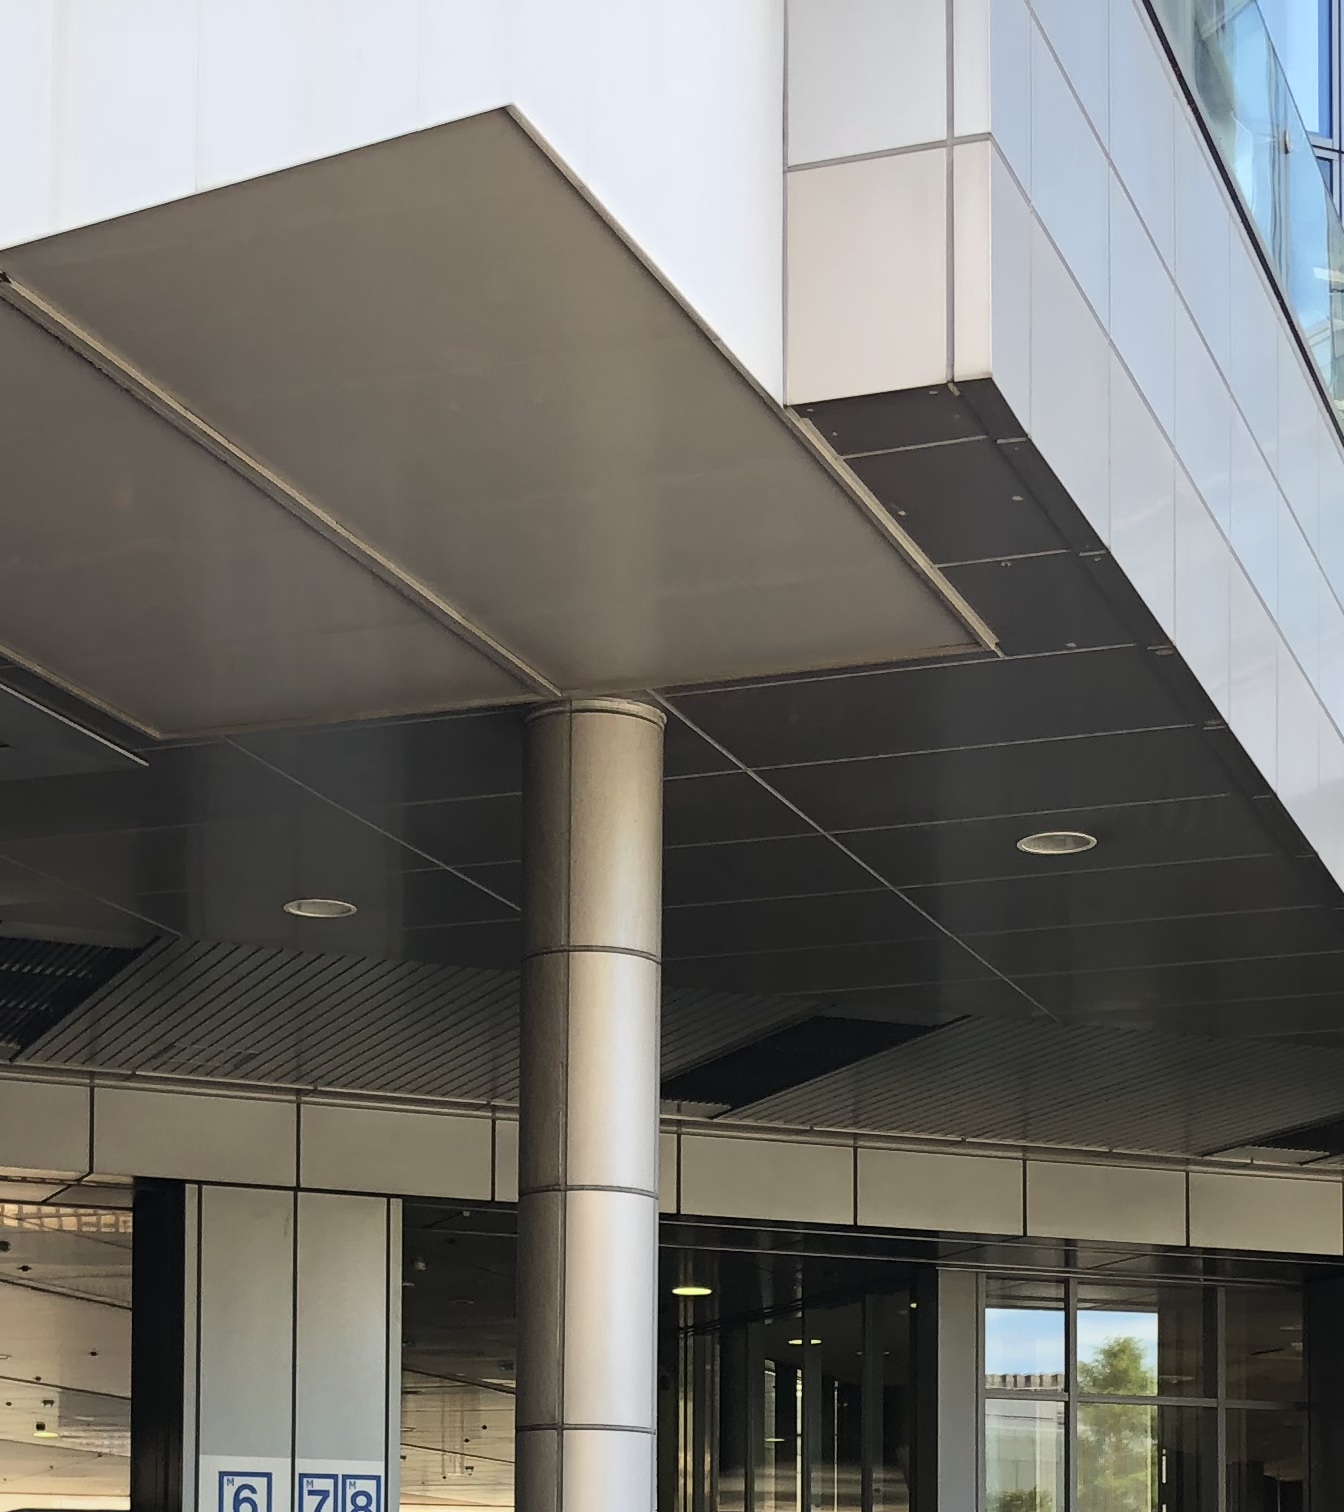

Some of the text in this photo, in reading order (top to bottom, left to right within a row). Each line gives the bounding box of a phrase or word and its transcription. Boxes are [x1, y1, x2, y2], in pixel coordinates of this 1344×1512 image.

[226, 1478, 235, 1487] M
[306, 1479, 314, 1488] M
[348, 1480, 357, 1490] M
